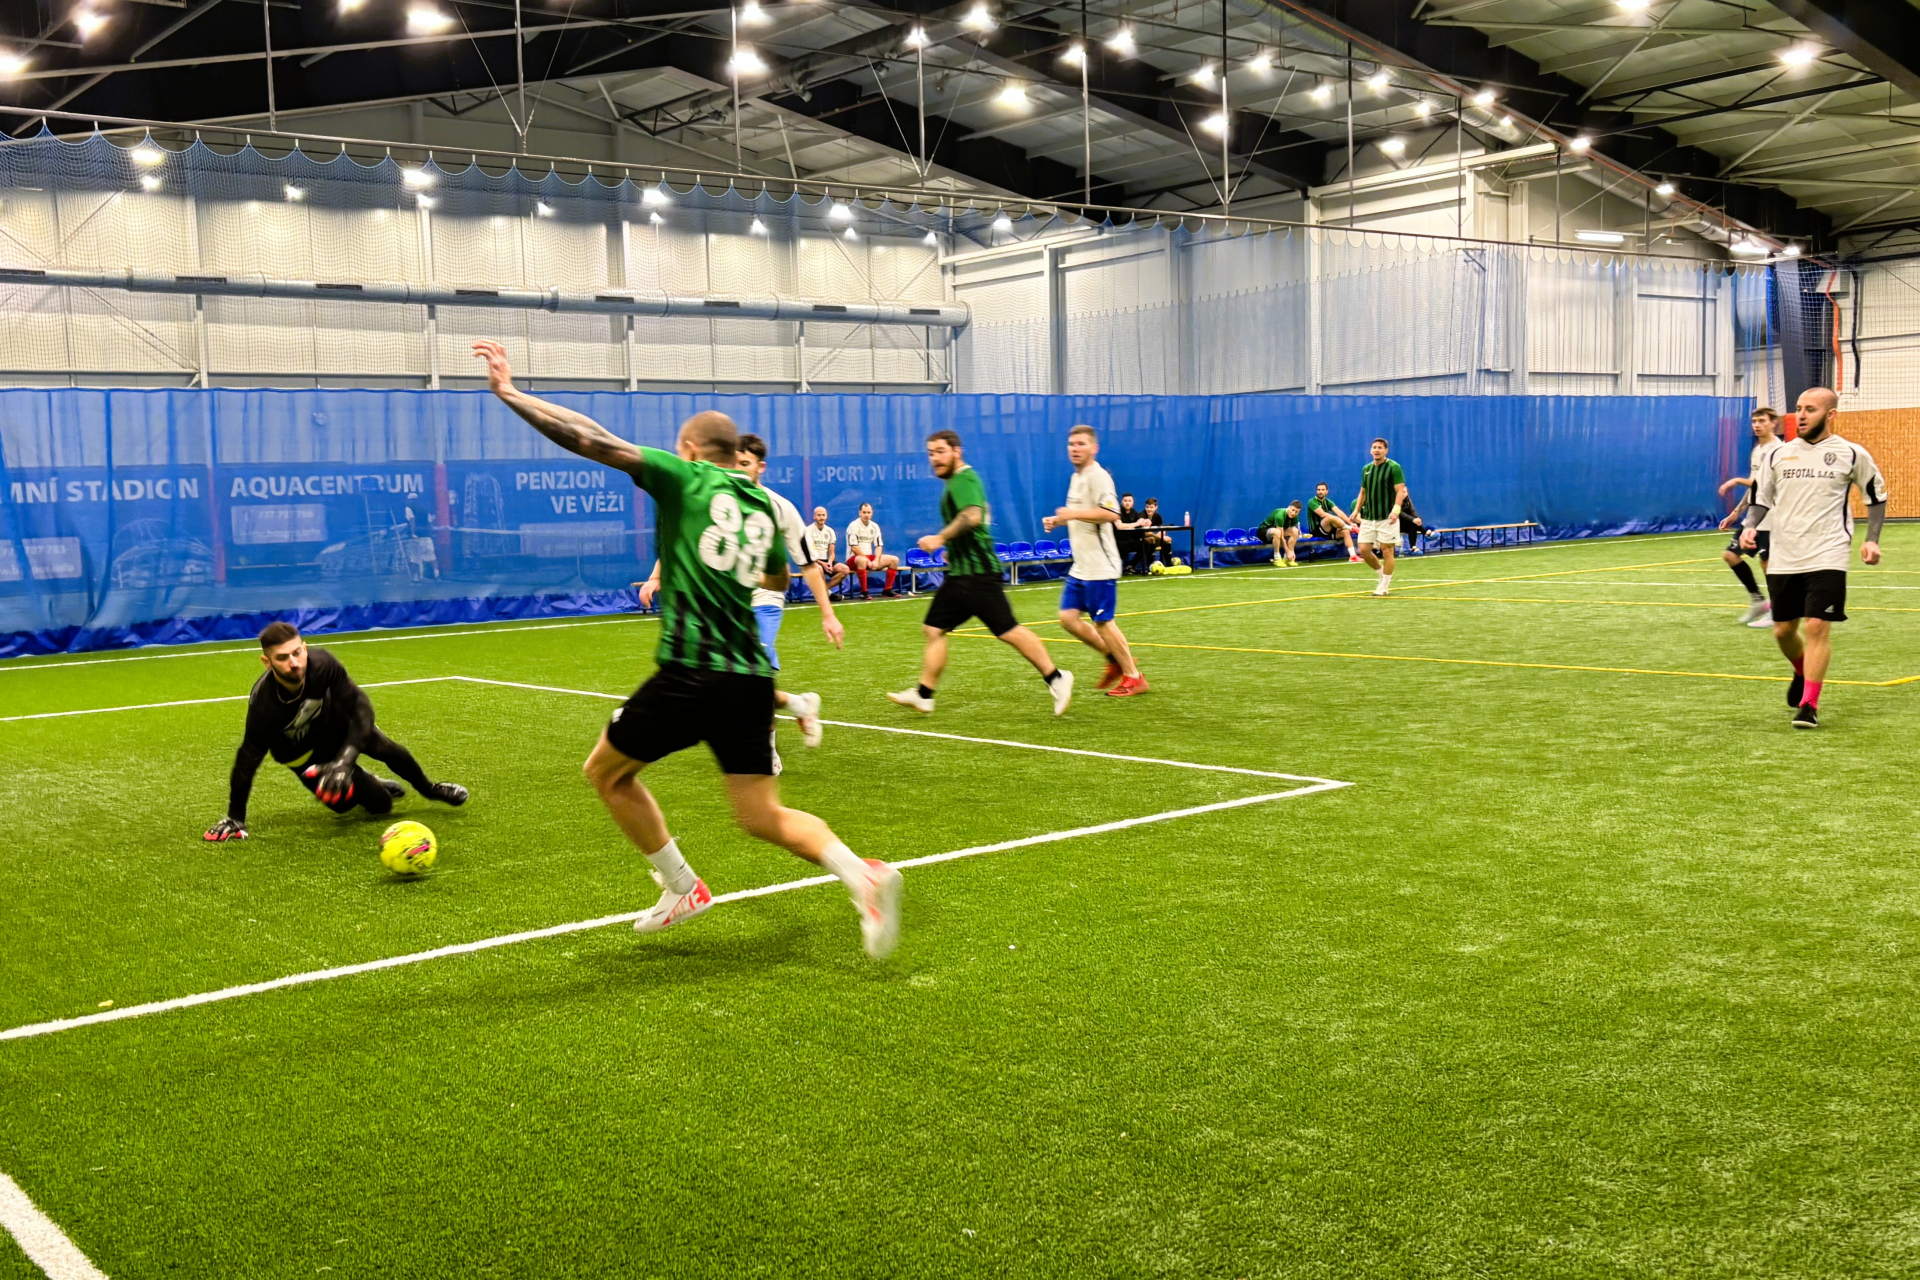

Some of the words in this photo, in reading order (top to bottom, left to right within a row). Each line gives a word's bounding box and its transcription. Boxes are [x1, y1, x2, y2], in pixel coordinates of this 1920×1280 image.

[516, 471, 605, 490] PENZION
[1783, 468, 1815, 479] REFOTAL
[230, 474, 424, 499] AQUACENTRUM
[550, 495, 578, 514] VE
[580, 491, 624, 513] VĚŽI
[698, 493, 775, 588] 88
